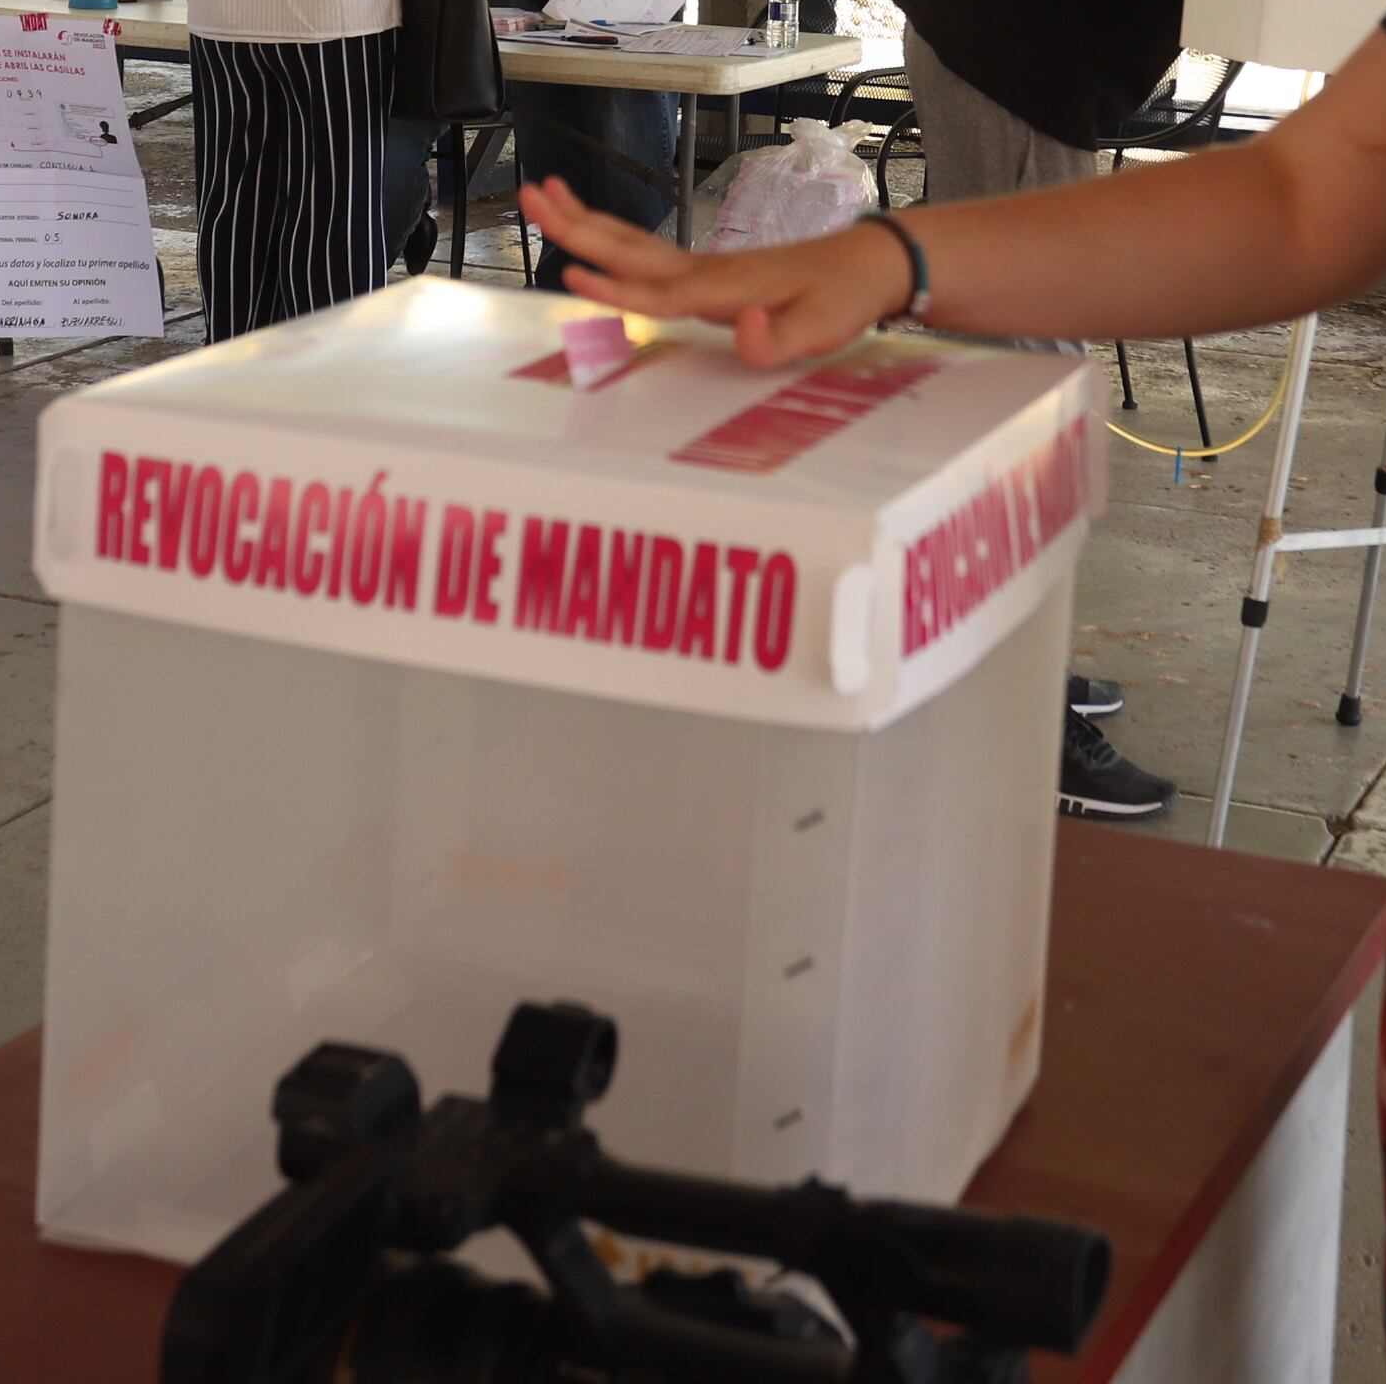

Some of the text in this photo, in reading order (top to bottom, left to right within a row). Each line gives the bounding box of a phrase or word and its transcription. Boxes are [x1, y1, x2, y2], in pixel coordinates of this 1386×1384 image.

[2, 48, 13, 57] SE
[14, 49, 66, 61] INSTALARÁN
[4, 61, 29, 70] ABRIL
[30, 62, 44, 72] LAS
[46, 64, 85, 76] CASILLAS
[56, 210, 99, 221] SONORA
[10, 258, 34, 268] datos
[36, 261, 41, 270] y
[43, 258, 76, 268] localiza
[78, 259, 87, 267] tu
[89, 259, 117, 270] primer
[118, 260, 150, 271] apellido
[8, 277, 106, 288] AQUÍ EMITEN SU OPINIÓN
[14, 299, 43, 308] apellido:
[82, 298, 110, 306] apellido:
[96, 451, 798, 673] REVOCACIÓN DE MANDATO
